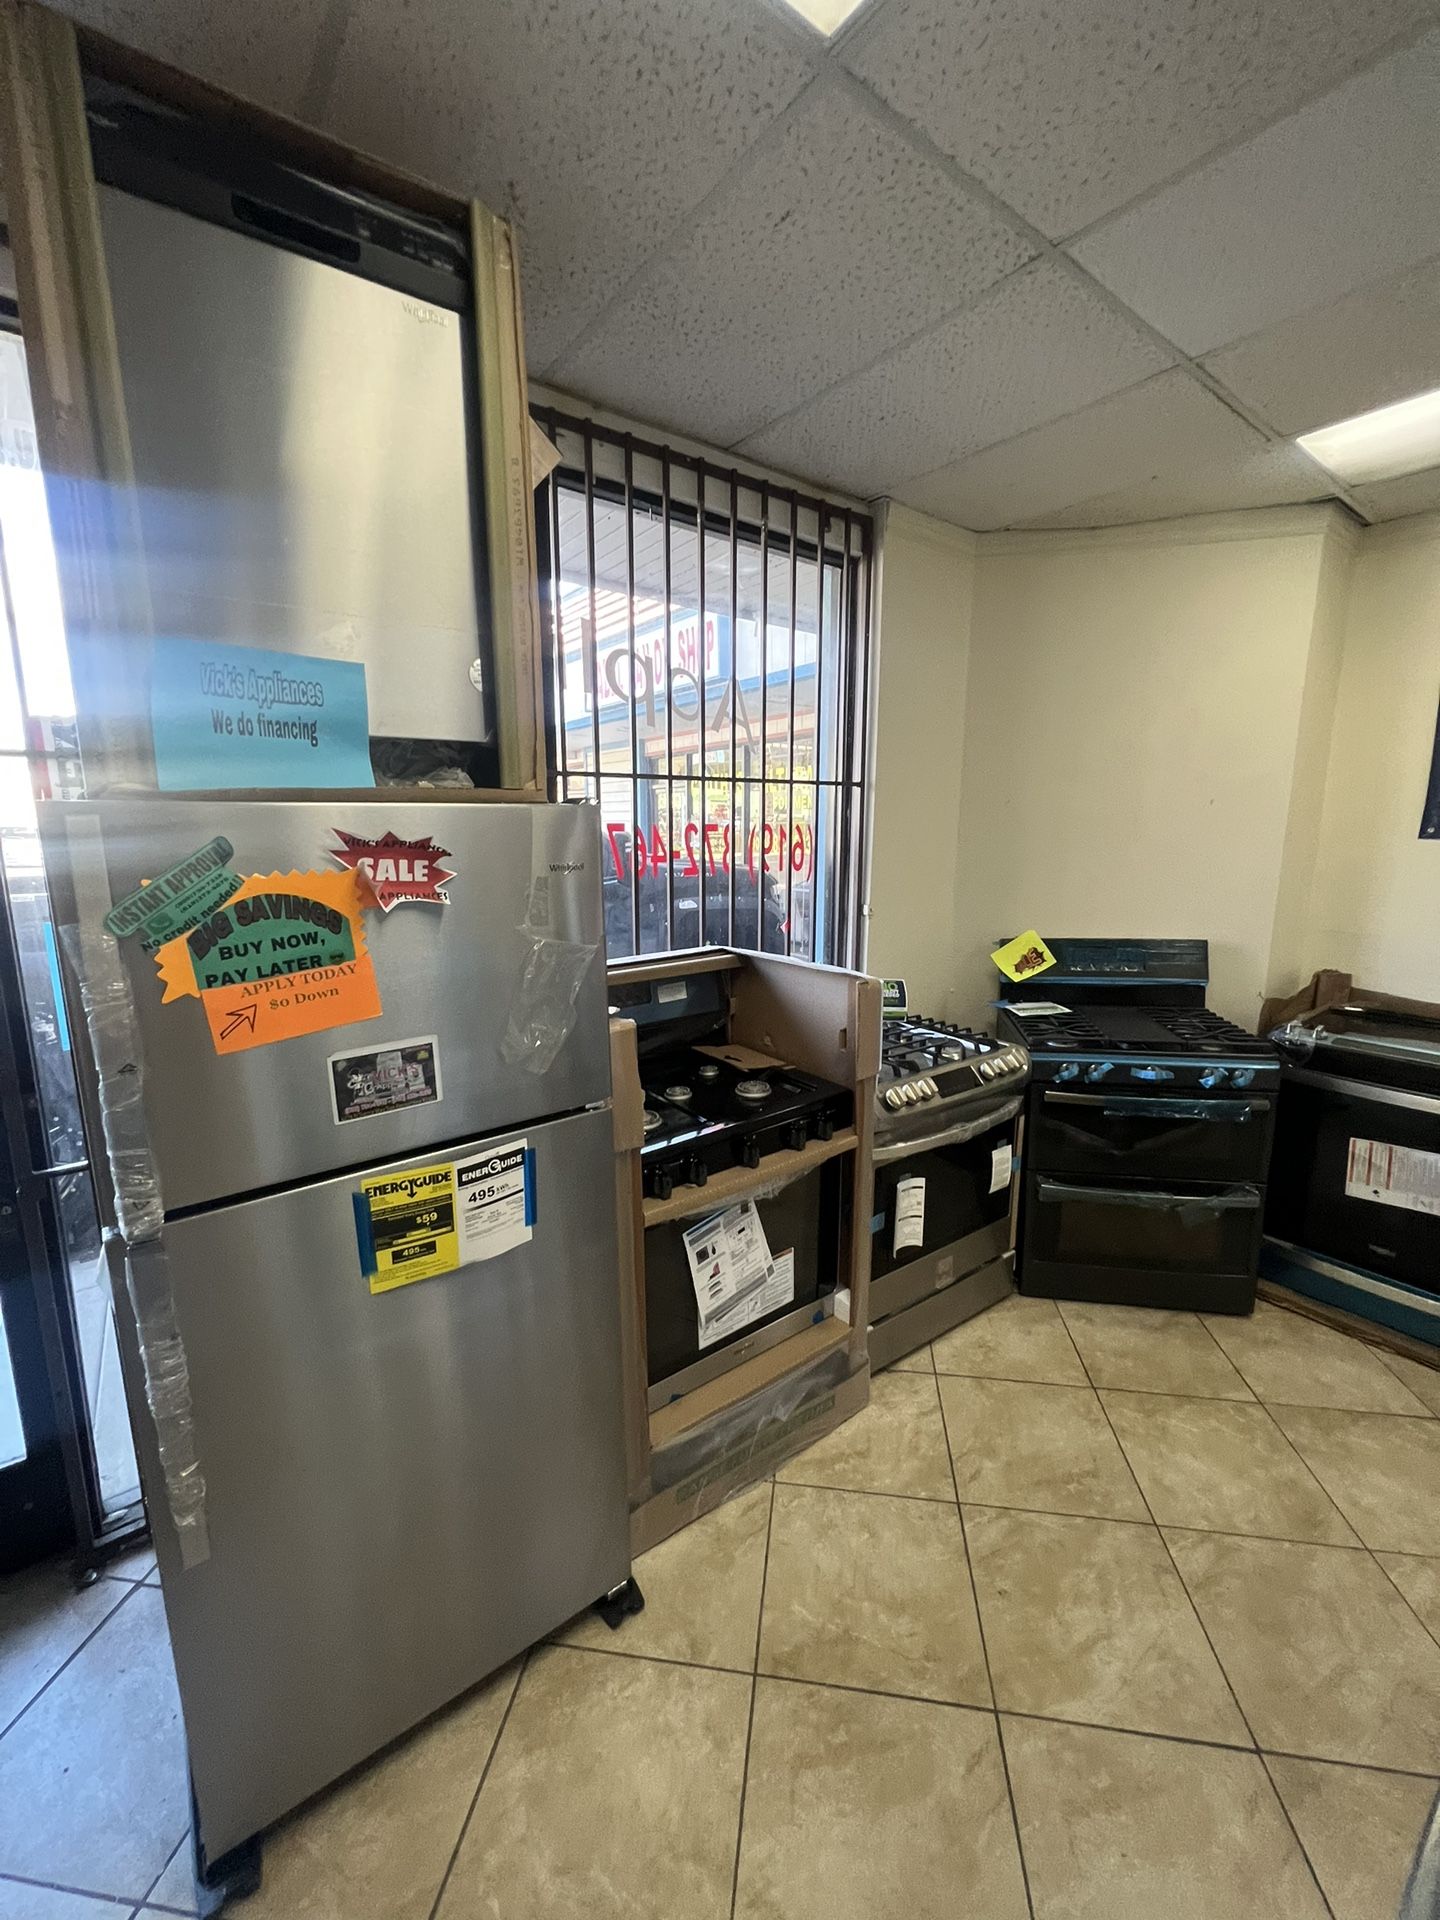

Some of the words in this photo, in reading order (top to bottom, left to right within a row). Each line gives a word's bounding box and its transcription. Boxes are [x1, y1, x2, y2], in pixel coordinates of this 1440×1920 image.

[678, 620, 714, 677] SHP
[201, 662, 244, 699] Vick's
[248, 668, 324, 709] Appliances
[211, 709, 233, 734] We
[238, 711, 254, 737] do
[257, 713, 318, 747] financing
[357, 857, 429, 882] SALE
[108, 882, 171, 933] INSTANT
[163, 841, 231, 895] APPROVAL
[141, 938, 160, 952] No
[164, 915, 201, 942] credit
[187, 911, 235, 960] BIG
[234, 893, 342, 935] SAVINGS
[219, 940, 264, 961] BUY
[272, 931, 326, 952] NOW,
[205, 968, 250, 988] PAY
[256, 955, 323, 979] LATER
[240, 976, 297, 998] APPLY
[298, 963, 357, 985] TODAY
[295, 986, 339, 1005] Down
[462, 1154, 523, 1181] ENERGUIDE
[365, 1171, 452, 1198] ENERGYGUIDE
[468, 1186, 495, 1203] 495
[416, 1212, 438, 1224] $59
[402, 1246, 420, 1256] 495
